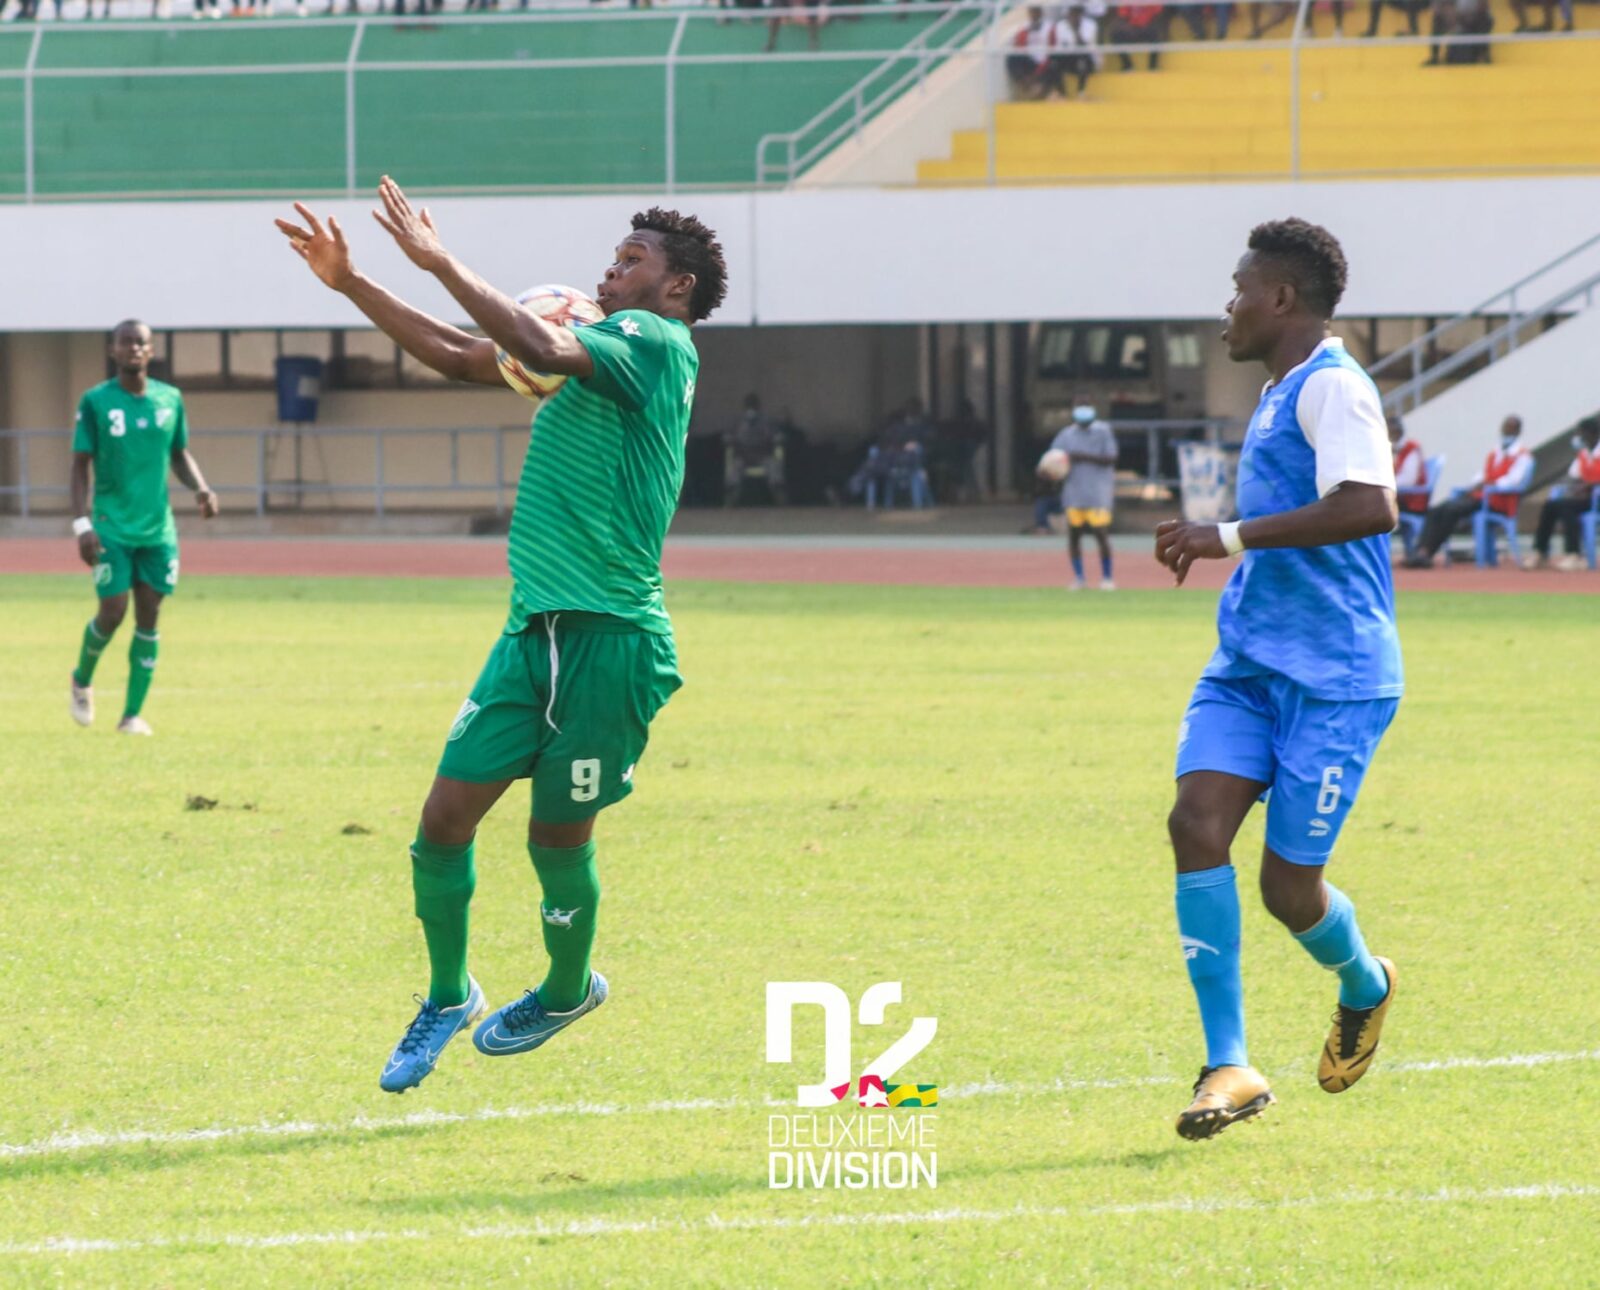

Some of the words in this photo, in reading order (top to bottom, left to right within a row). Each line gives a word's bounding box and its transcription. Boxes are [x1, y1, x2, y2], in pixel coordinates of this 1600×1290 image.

[108, 409, 126, 437] 3
[571, 758, 600, 802] 9
[1316, 766, 1344, 814] 6
